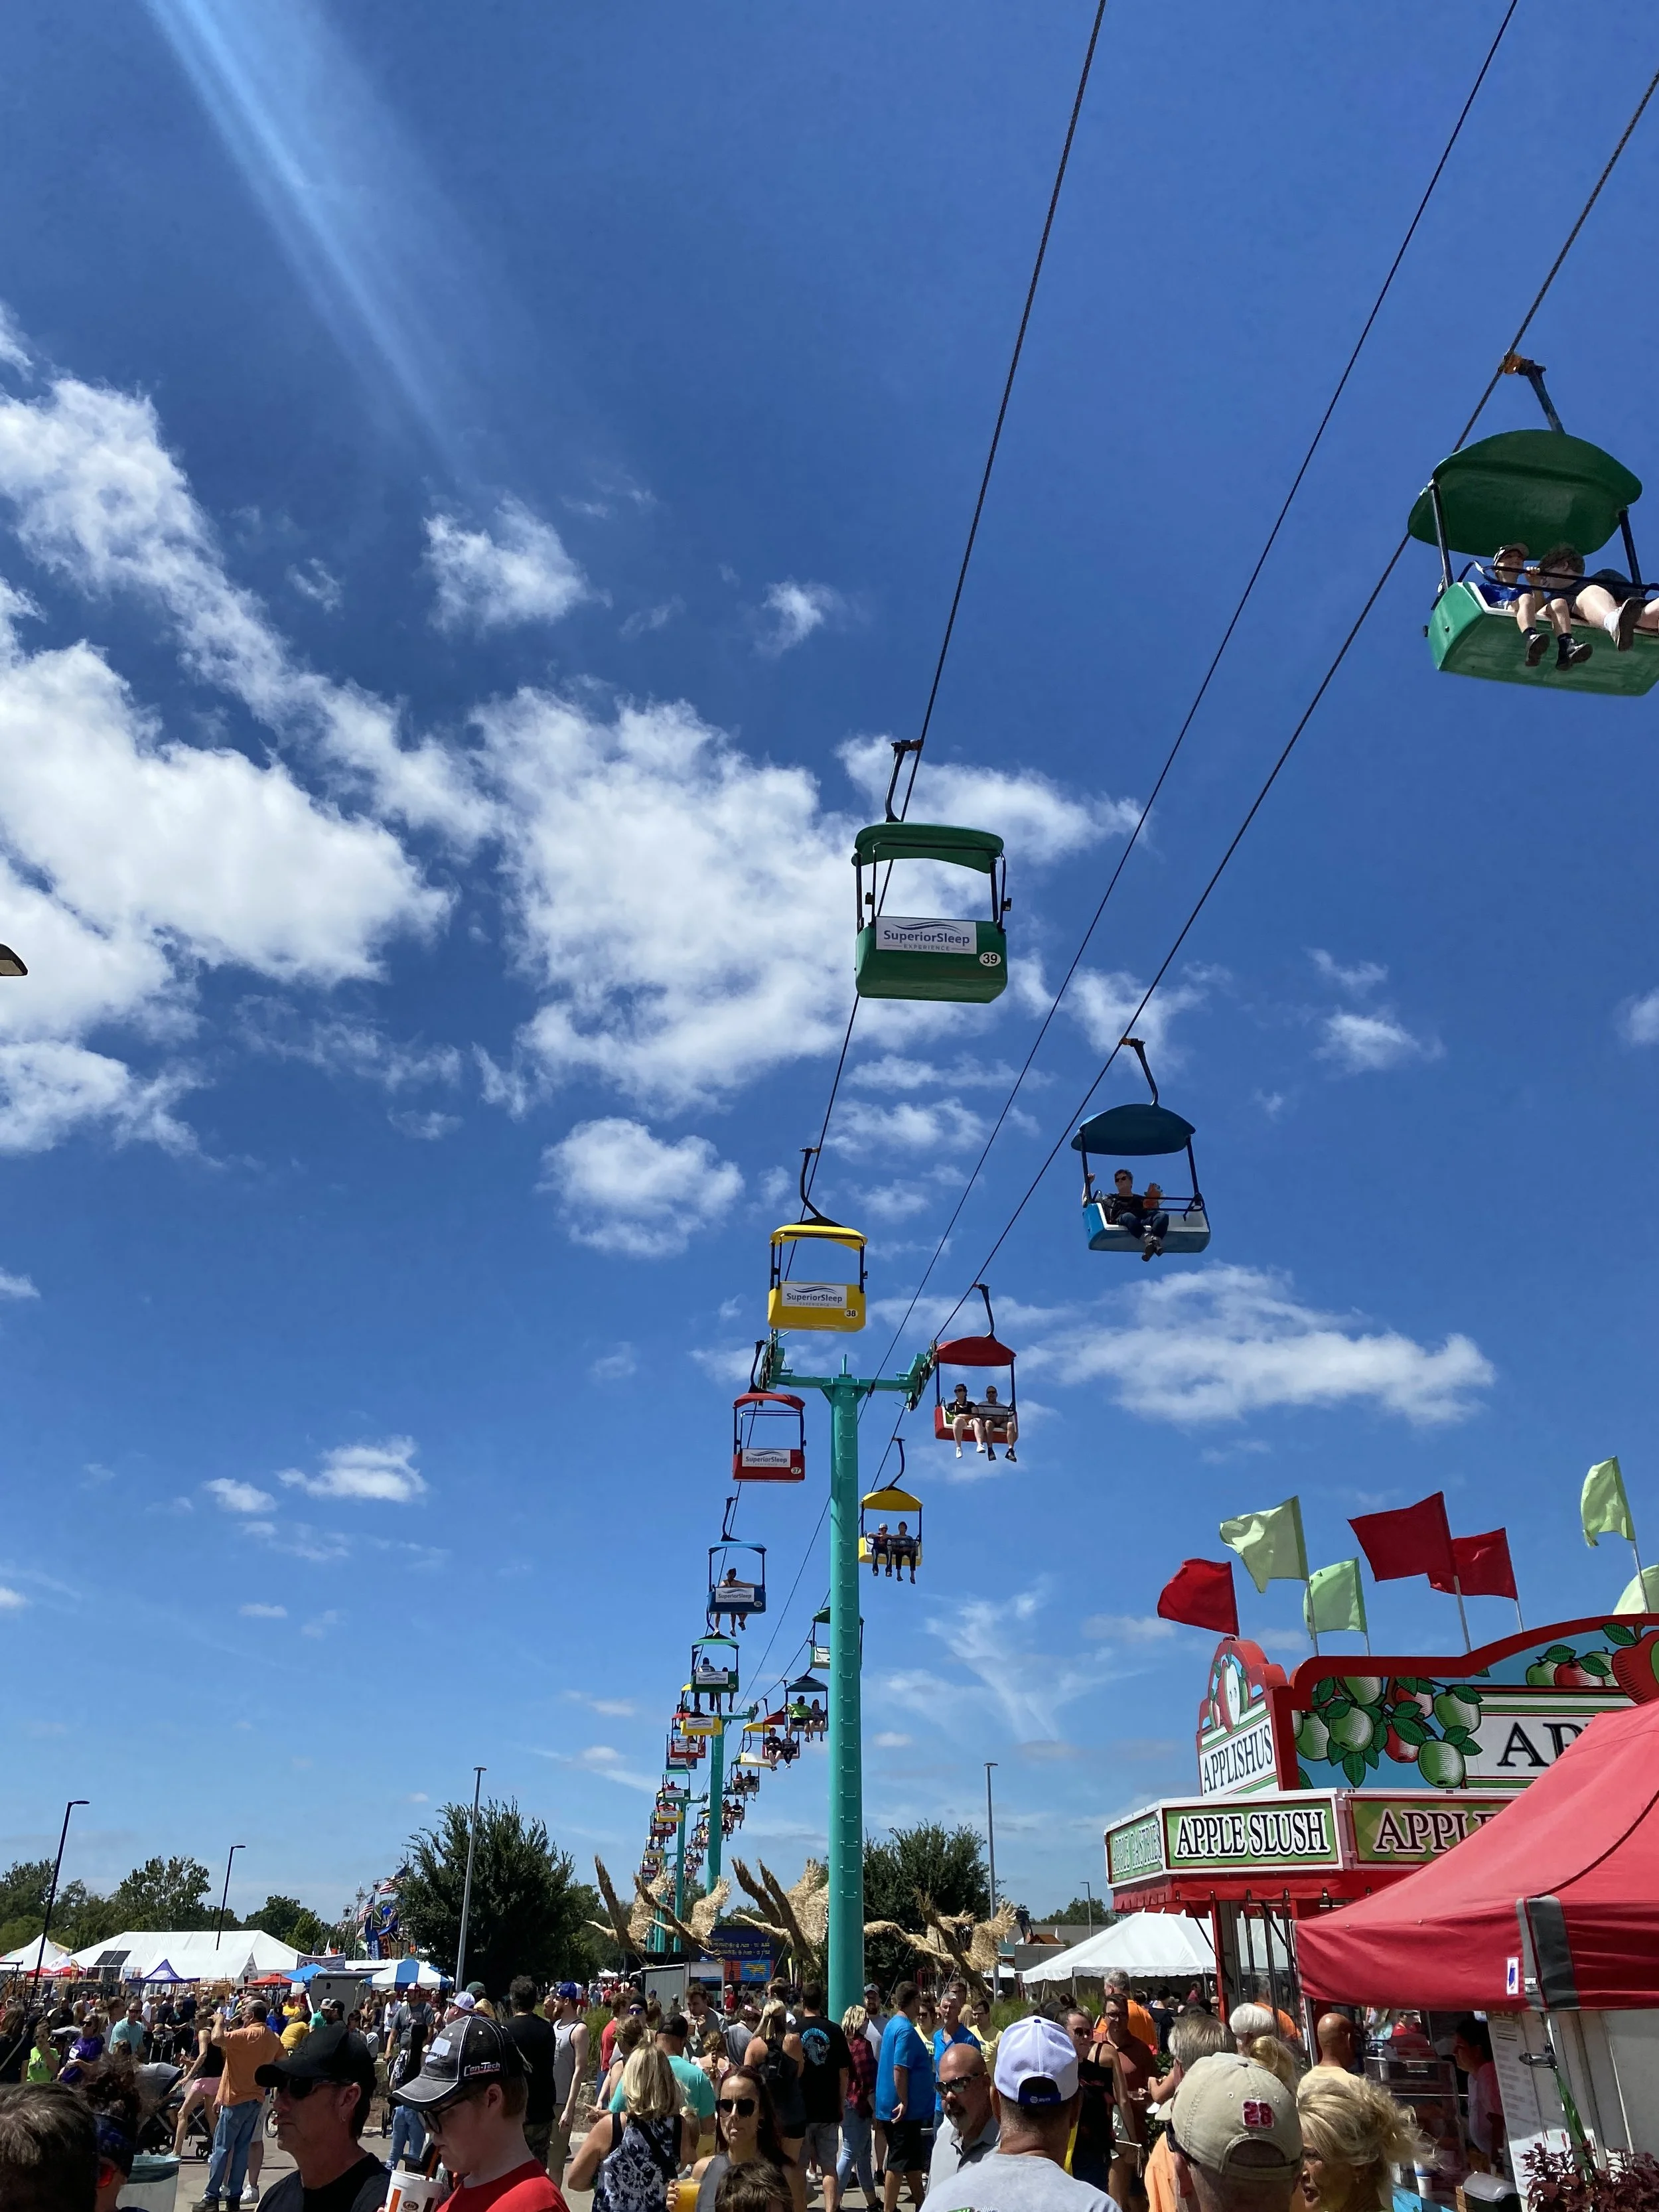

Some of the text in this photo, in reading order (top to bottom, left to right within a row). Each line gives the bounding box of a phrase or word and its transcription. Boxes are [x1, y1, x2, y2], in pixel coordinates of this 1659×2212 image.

[883, 930, 970, 946] SuperiorSleep
[982, 953, 998, 964] 39
[786, 1293, 843, 1303] SuperiorSleep
[1203, 1724, 1273, 1794] APPLISHUS
[1177, 1811, 1328, 1856] APPLE SLUSH
